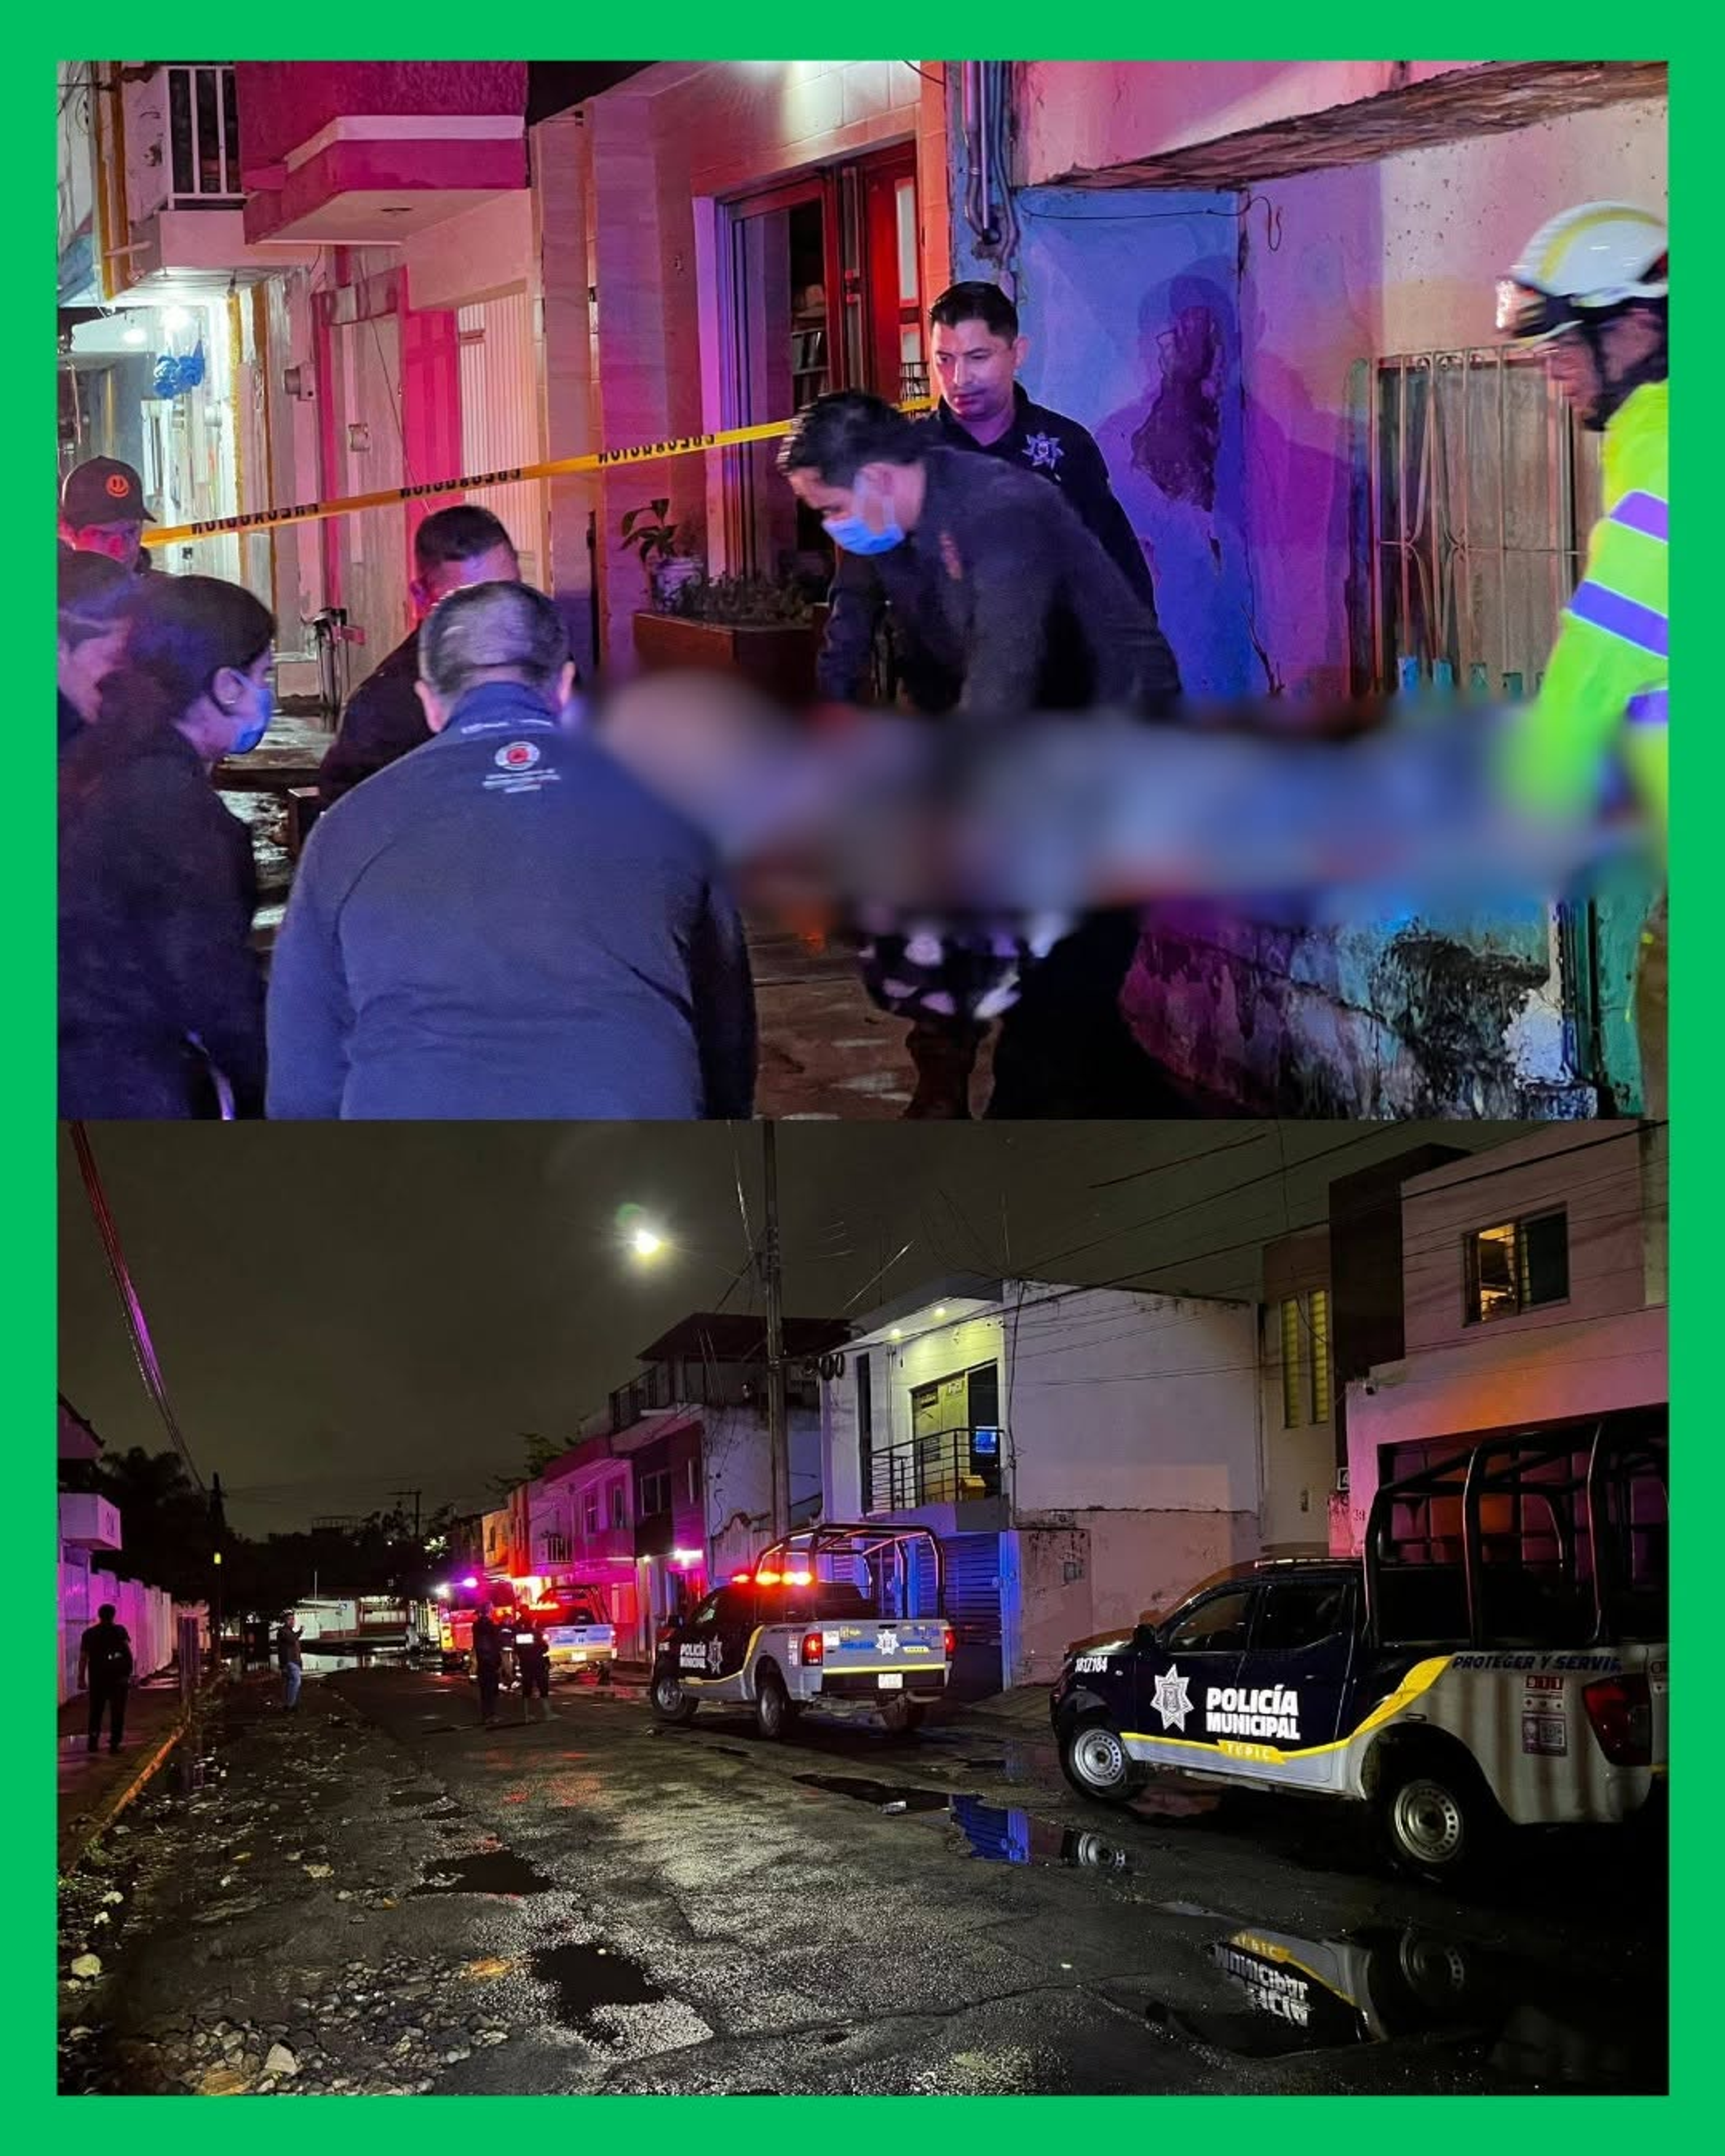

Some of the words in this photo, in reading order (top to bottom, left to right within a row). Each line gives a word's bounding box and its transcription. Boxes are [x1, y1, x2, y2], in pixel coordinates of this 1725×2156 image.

[1452, 1656, 1535, 1669] PROTEGER
[1541, 1656, 1551, 1669] Y
[1528, 1676, 1560, 1689] 911
[1206, 1684, 1299, 1716] POLICÍA
[1206, 1712, 1301, 1740] MUNICIPAL
